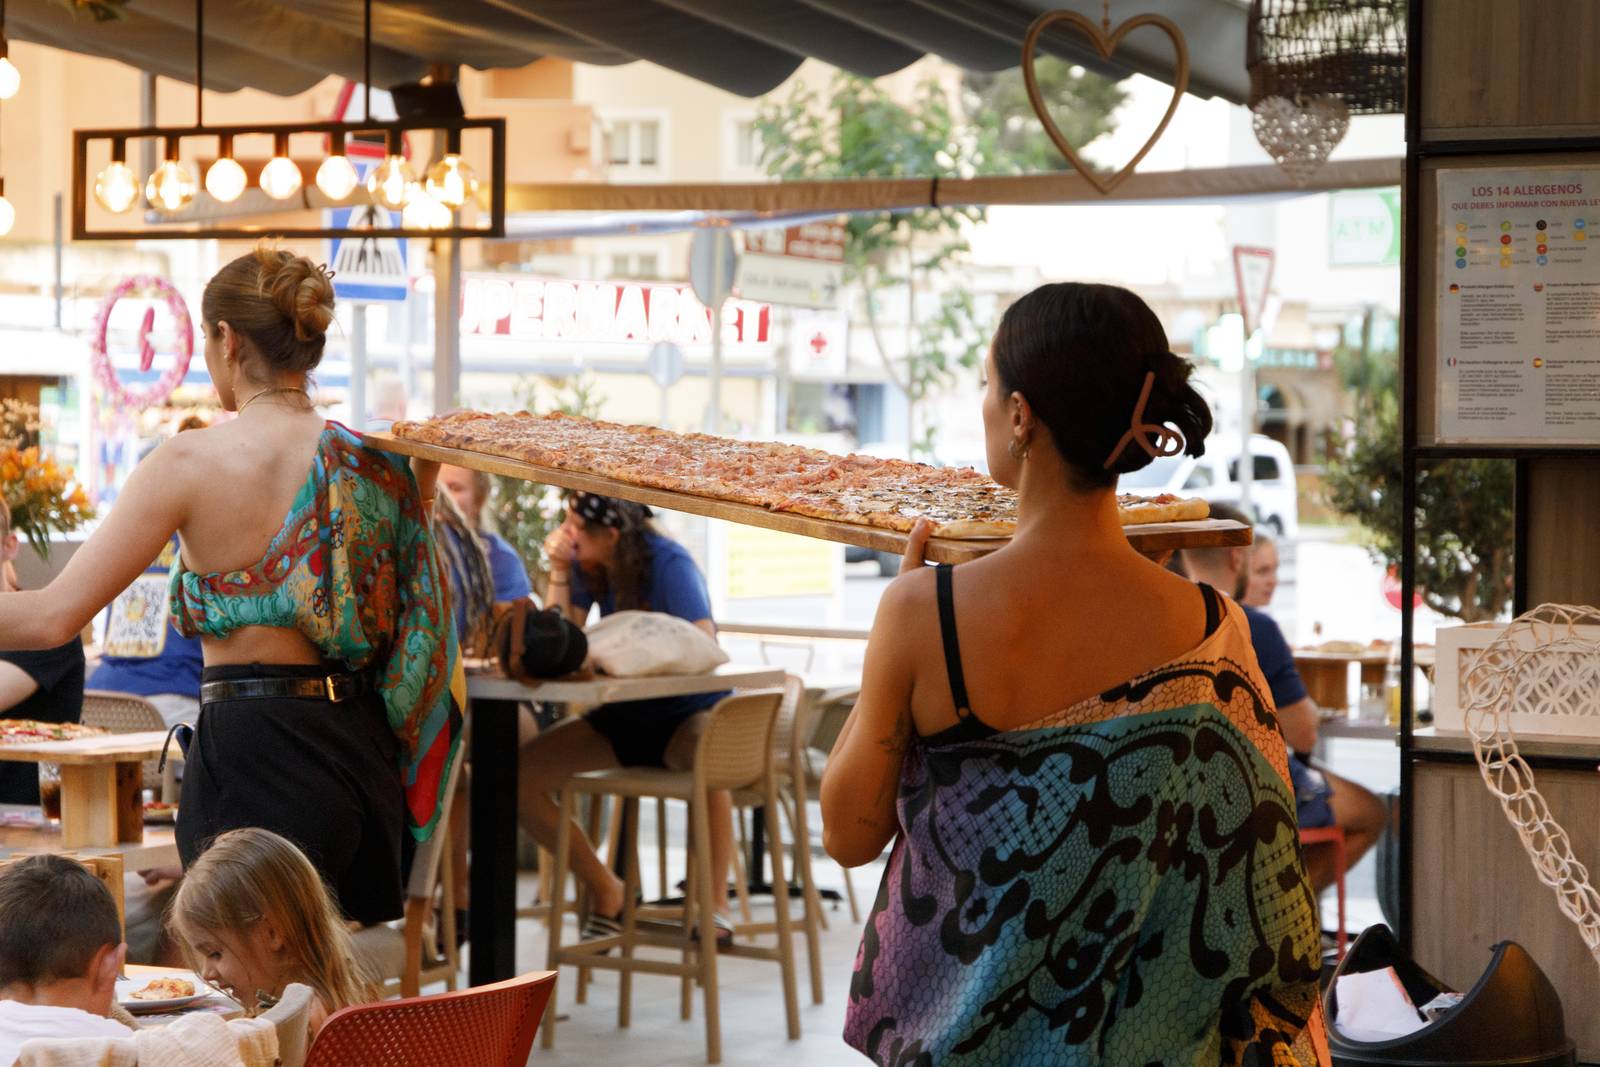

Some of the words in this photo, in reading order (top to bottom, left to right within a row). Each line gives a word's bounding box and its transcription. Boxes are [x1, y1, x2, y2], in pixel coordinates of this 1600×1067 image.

[1472, 186, 1494, 197] LOS
[1497, 186, 1510, 196] 14
[1514, 184, 1583, 196] ALERGENOS
[1452, 202, 1469, 211] QUE
[1496, 200, 1539, 209] INFORMAR
[1541, 199, 1558, 208] CON
[1560, 199, 1588, 207] NUEVA
